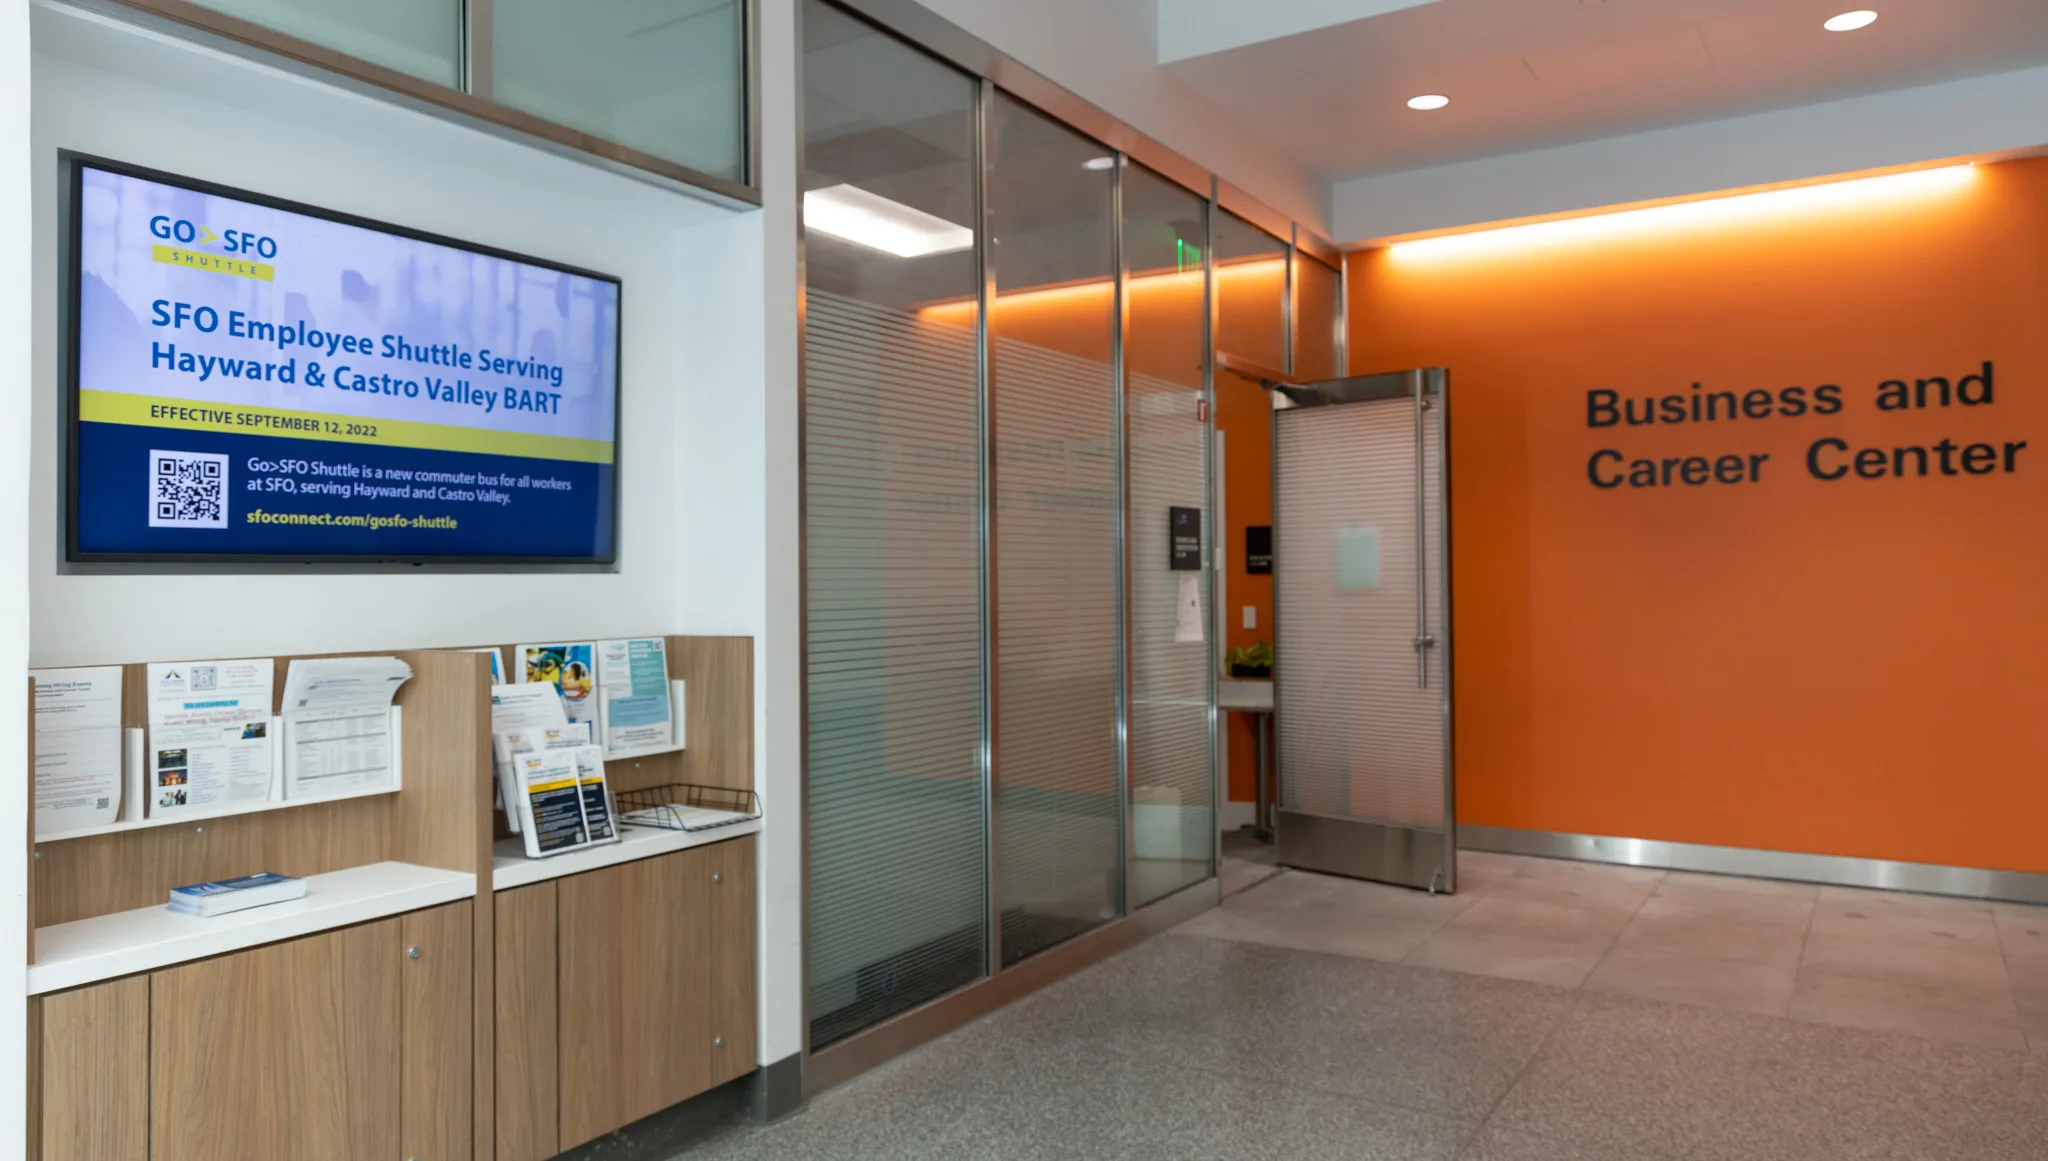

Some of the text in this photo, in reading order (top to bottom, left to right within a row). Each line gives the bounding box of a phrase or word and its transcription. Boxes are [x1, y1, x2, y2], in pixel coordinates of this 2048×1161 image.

[173, 252, 257, 275] SHUTTLE
[151, 299, 563, 387] SFO Employee Shuttle Serving
[151, 341, 562, 414] Hayward & Castro Valley BART
[1586, 361, 1995, 428] Business and
[150, 404, 377, 437] EFFECTIVE SEPTEMBER 12, 2022
[310, 461, 360, 477] Shuttle
[362, 465, 373, 479] is
[374, 469, 383, 479] a
[385, 469, 413, 481] new
[414, 470, 476, 485] commuter
[477, 472, 499, 486] bus
[499, 473, 515, 487] for
[517, 475, 530, 488] all
[531, 477, 572, 491] workers
[1586, 437, 2028, 489] Career Center
[247, 477, 512, 506] at SFO, serving Hayward and Castro Valley.
[246, 508, 458, 531] sfoconnect.com/gosfo-shuttle
